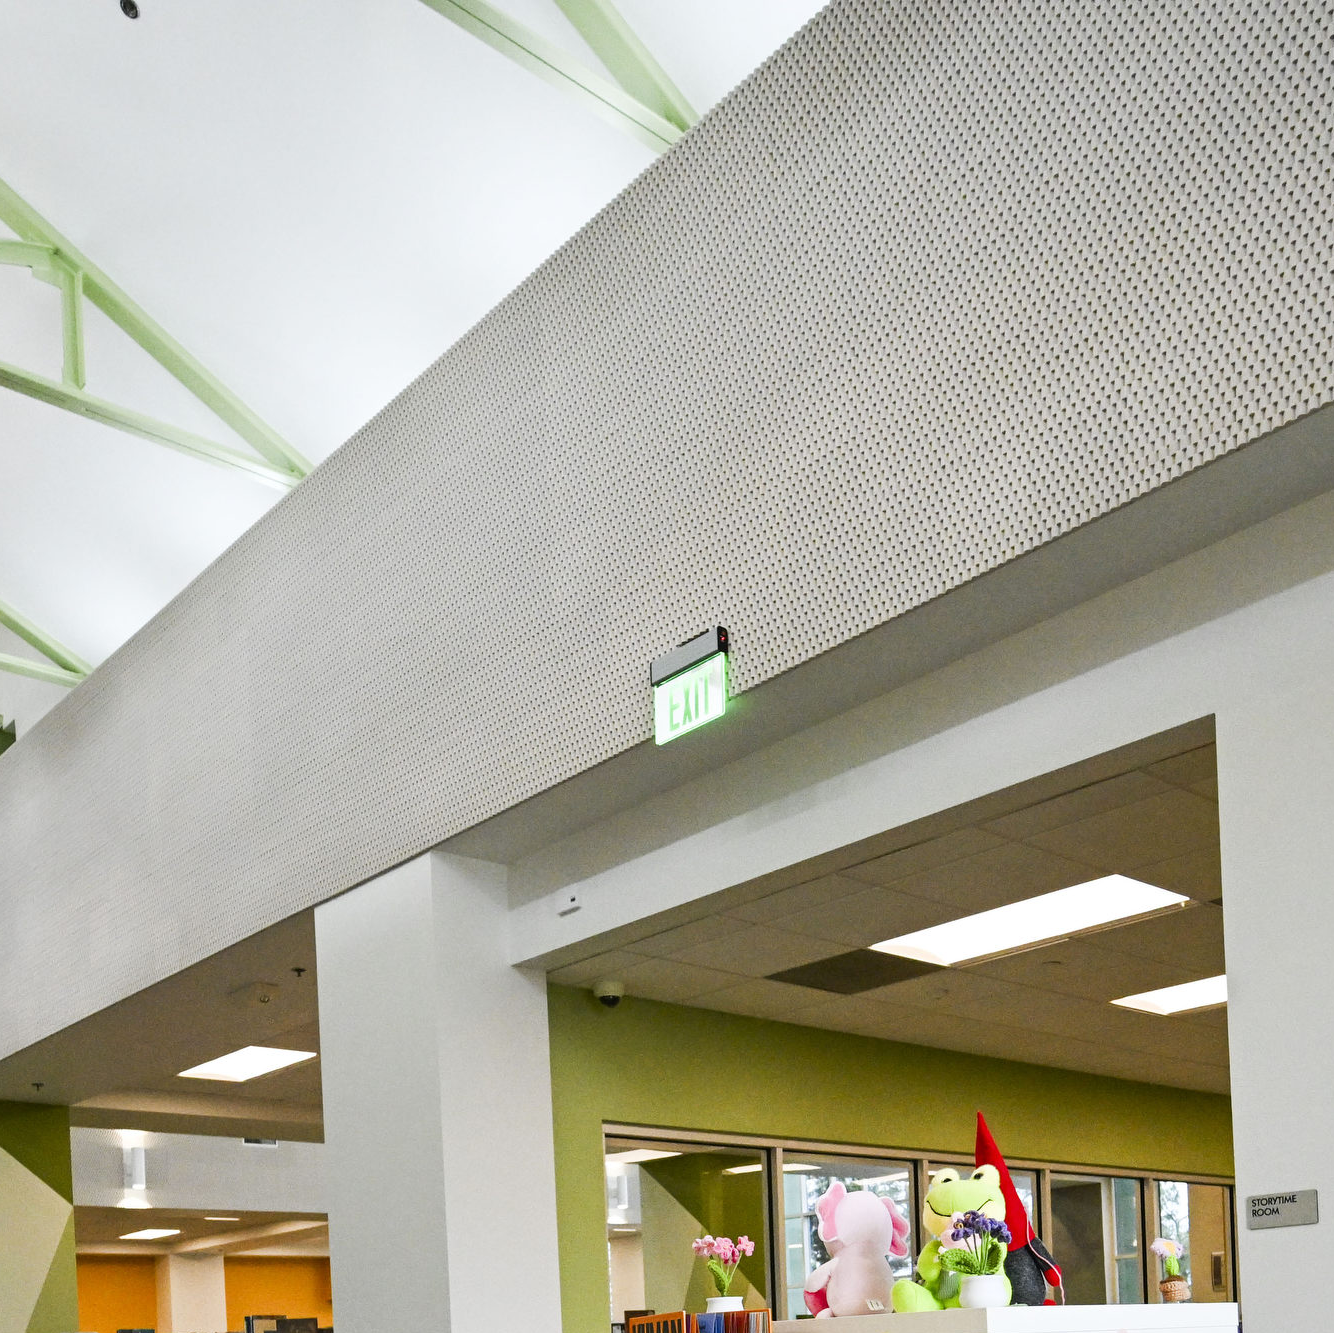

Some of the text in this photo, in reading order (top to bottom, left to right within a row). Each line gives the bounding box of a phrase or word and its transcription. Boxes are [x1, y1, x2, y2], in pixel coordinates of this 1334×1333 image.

[669, 666, 713, 731] EXIT
[1251, 1194, 1297, 1207] STORYTIME
[1251, 1207, 1280, 1217] ROOM
